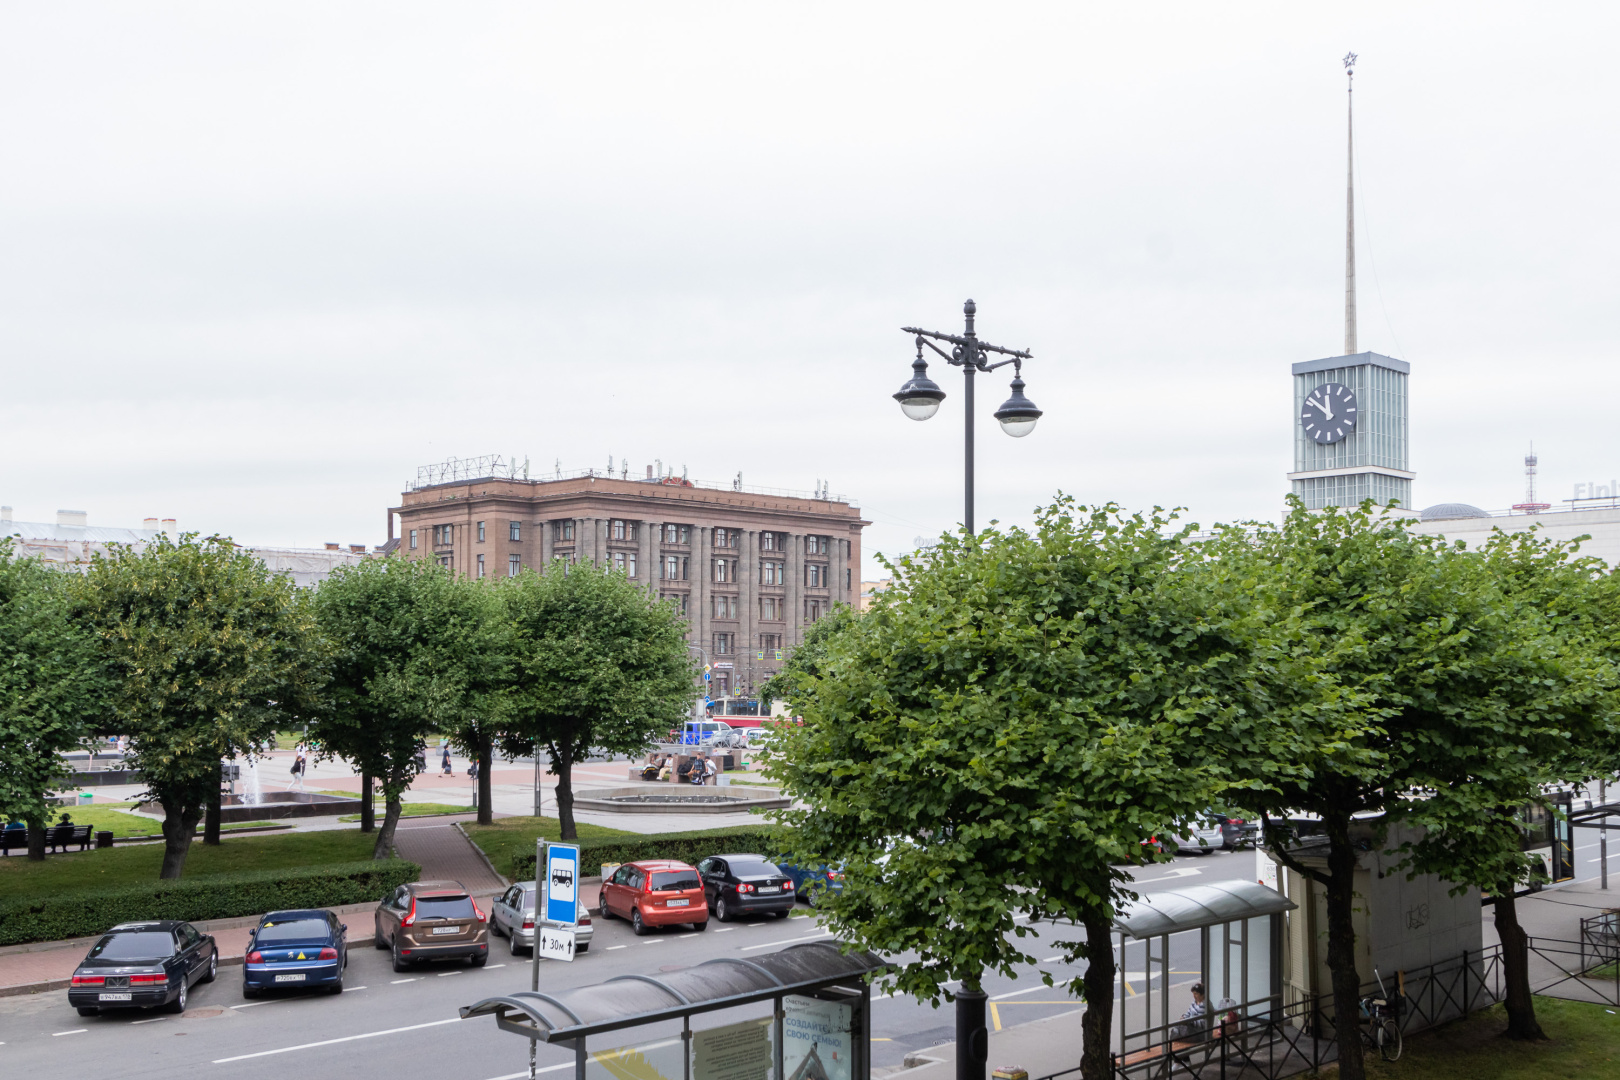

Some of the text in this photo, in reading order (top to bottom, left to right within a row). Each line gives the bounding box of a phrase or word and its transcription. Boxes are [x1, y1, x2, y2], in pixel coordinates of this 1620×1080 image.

[1574, 480, 1620, 499] Finl
[786, 1017, 828, 1033] СОЗДАЙТЕ
[786, 1029, 842, 1048] СВОЮ СЕМЬЮ!
